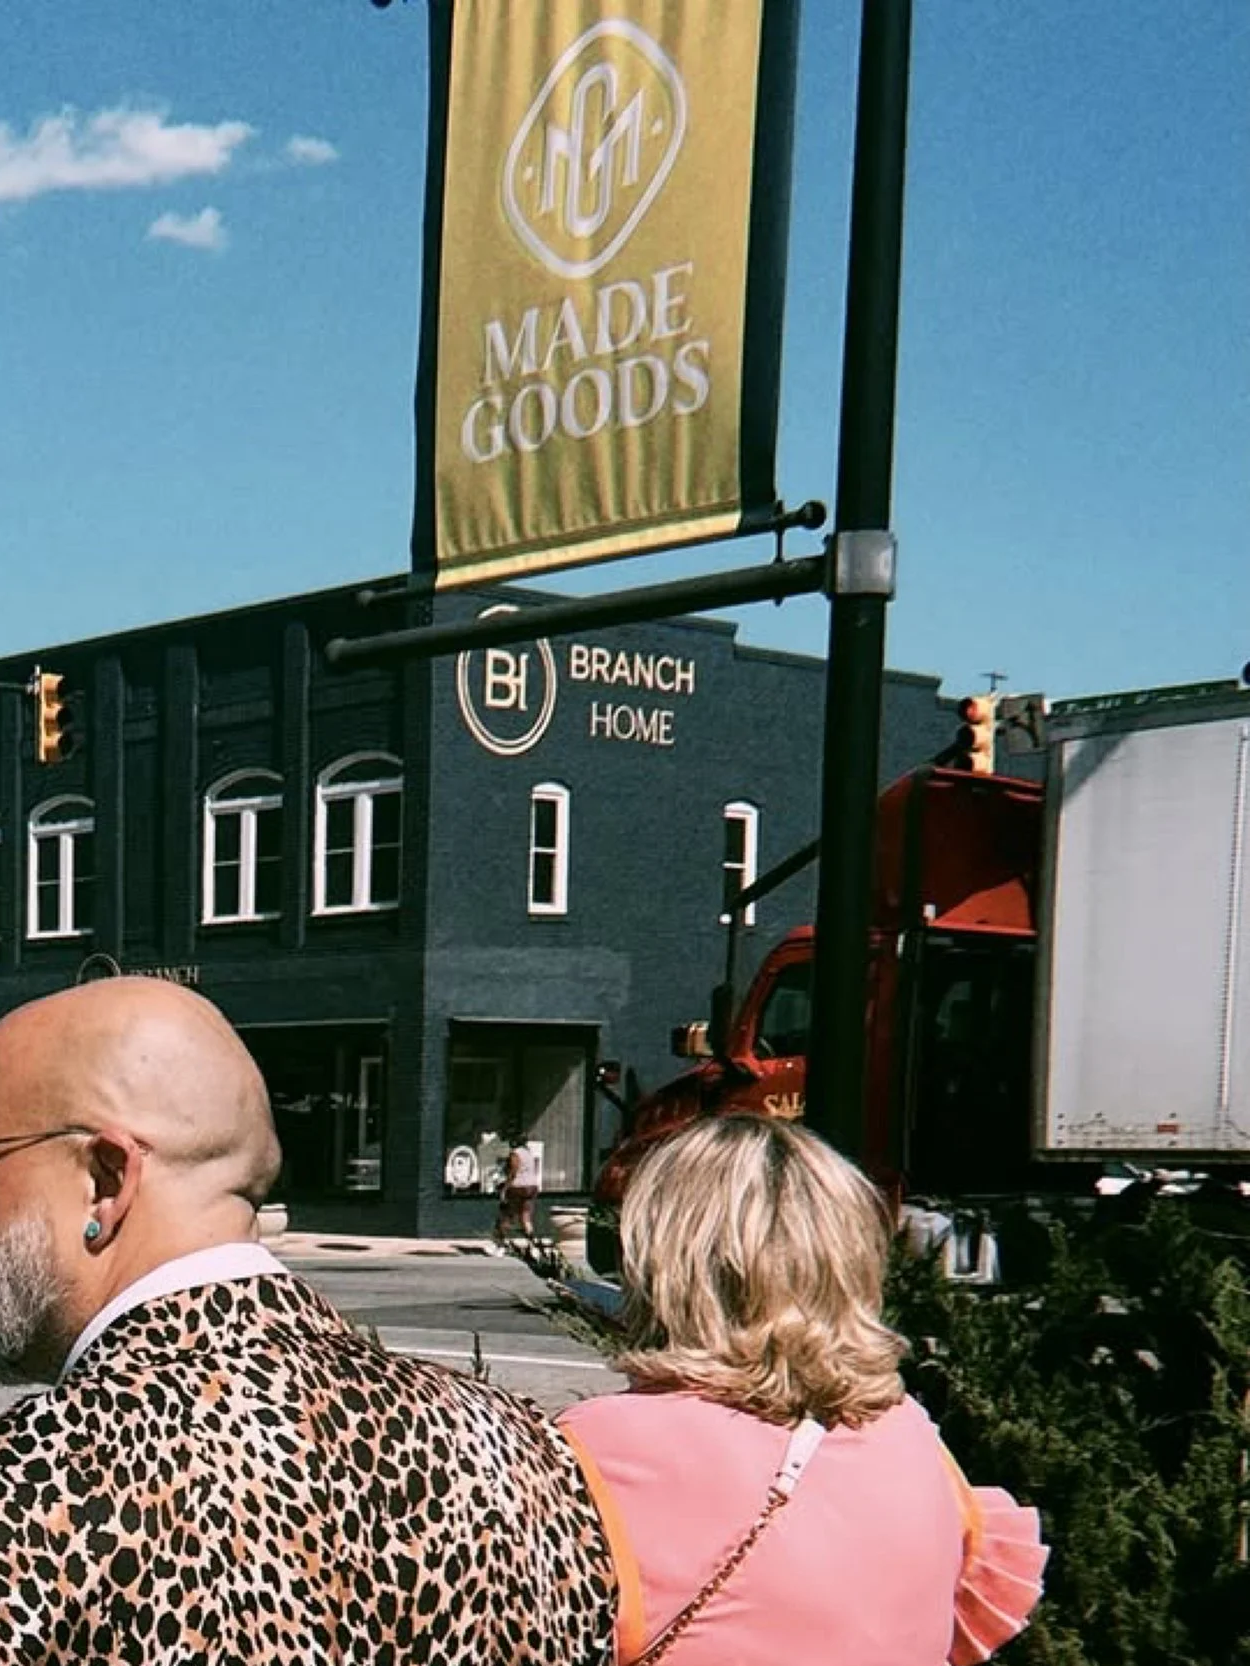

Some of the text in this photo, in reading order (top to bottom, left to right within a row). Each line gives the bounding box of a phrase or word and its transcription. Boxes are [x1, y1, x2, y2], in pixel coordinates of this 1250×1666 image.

[482, 261, 694, 387] MADE
[460, 340, 710, 463] GOODS
[570, 643, 695, 694] BRANCH
[589, 701, 675, 745] HOME
